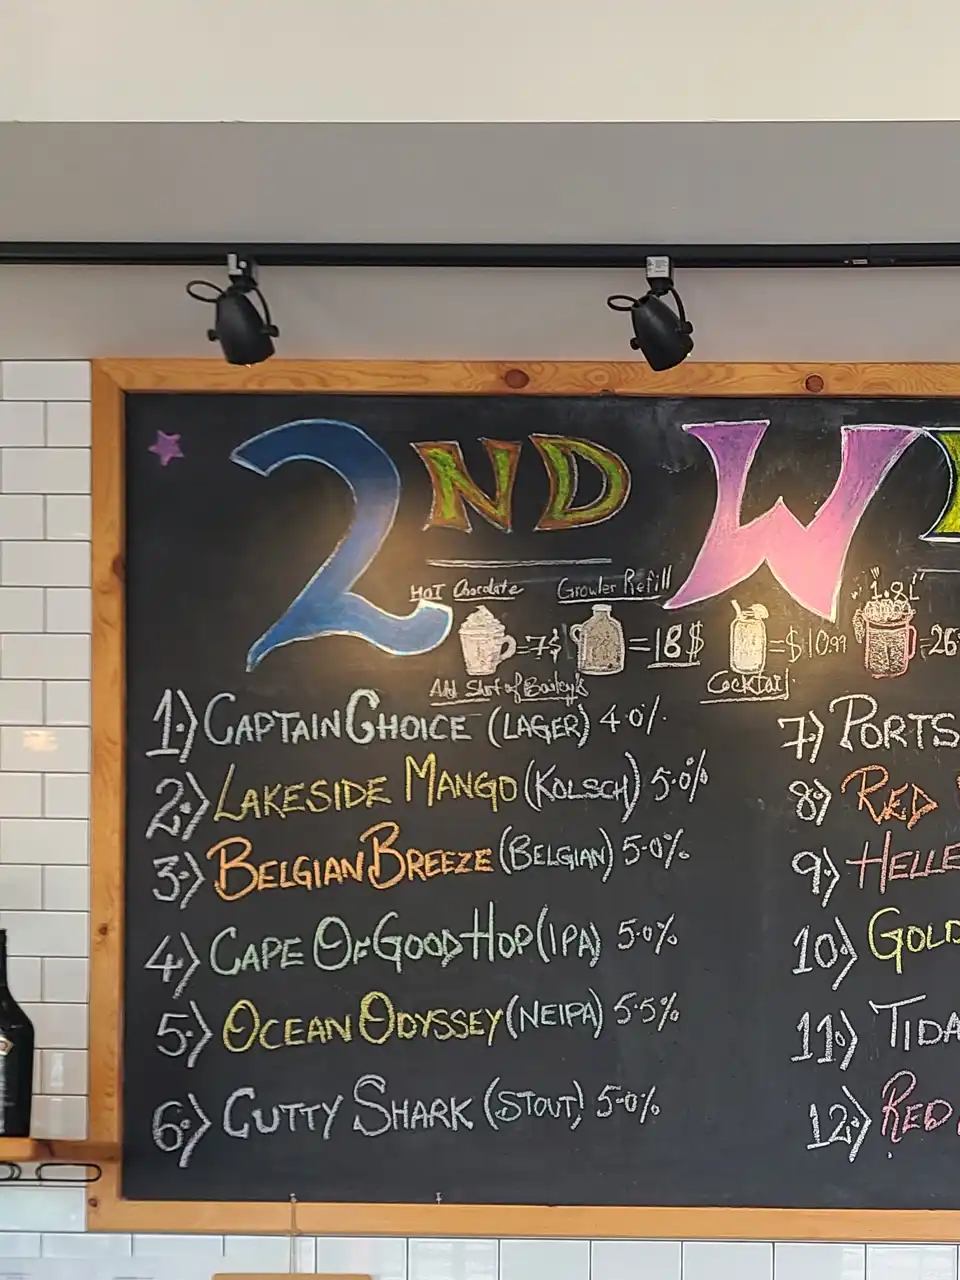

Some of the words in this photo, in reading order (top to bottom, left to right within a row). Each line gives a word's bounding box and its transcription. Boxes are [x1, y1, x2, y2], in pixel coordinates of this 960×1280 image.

[557, 577, 617, 599] Growler
[624, 565, 673, 597] Refill
[203, 692, 341, 746] CAPTAIN
[488, 703, 591, 748] (LAGER)
[213, 763, 393, 821] LAKESIDE
[405, 752, 518, 812] MANGO
[524, 751, 641, 823] (KOLSCH)
[840, 764, 940, 830] RED
[206, 836, 365, 901] BELGIAN
[360, 821, 496, 890] BREEZE
[500, 825, 614, 883] (BELGIAN)
[210, 926, 304, 976] CAPE
[313, 916, 372, 971] OF
[373, 911, 464, 974] GOOD
[459, 901, 534, 962] HOP
[536, 904, 601, 968] (IPA)
[223, 999, 352, 1052] OCEAN
[359, 991, 503, 1046] ODYSSEY
[506, 988, 604, 1039] (NEIPA)
[352, 1074, 474, 1137] SHARK
[484, 1077, 585, 1131] (STOUT)
[881, 1070, 954, 1145] RED
